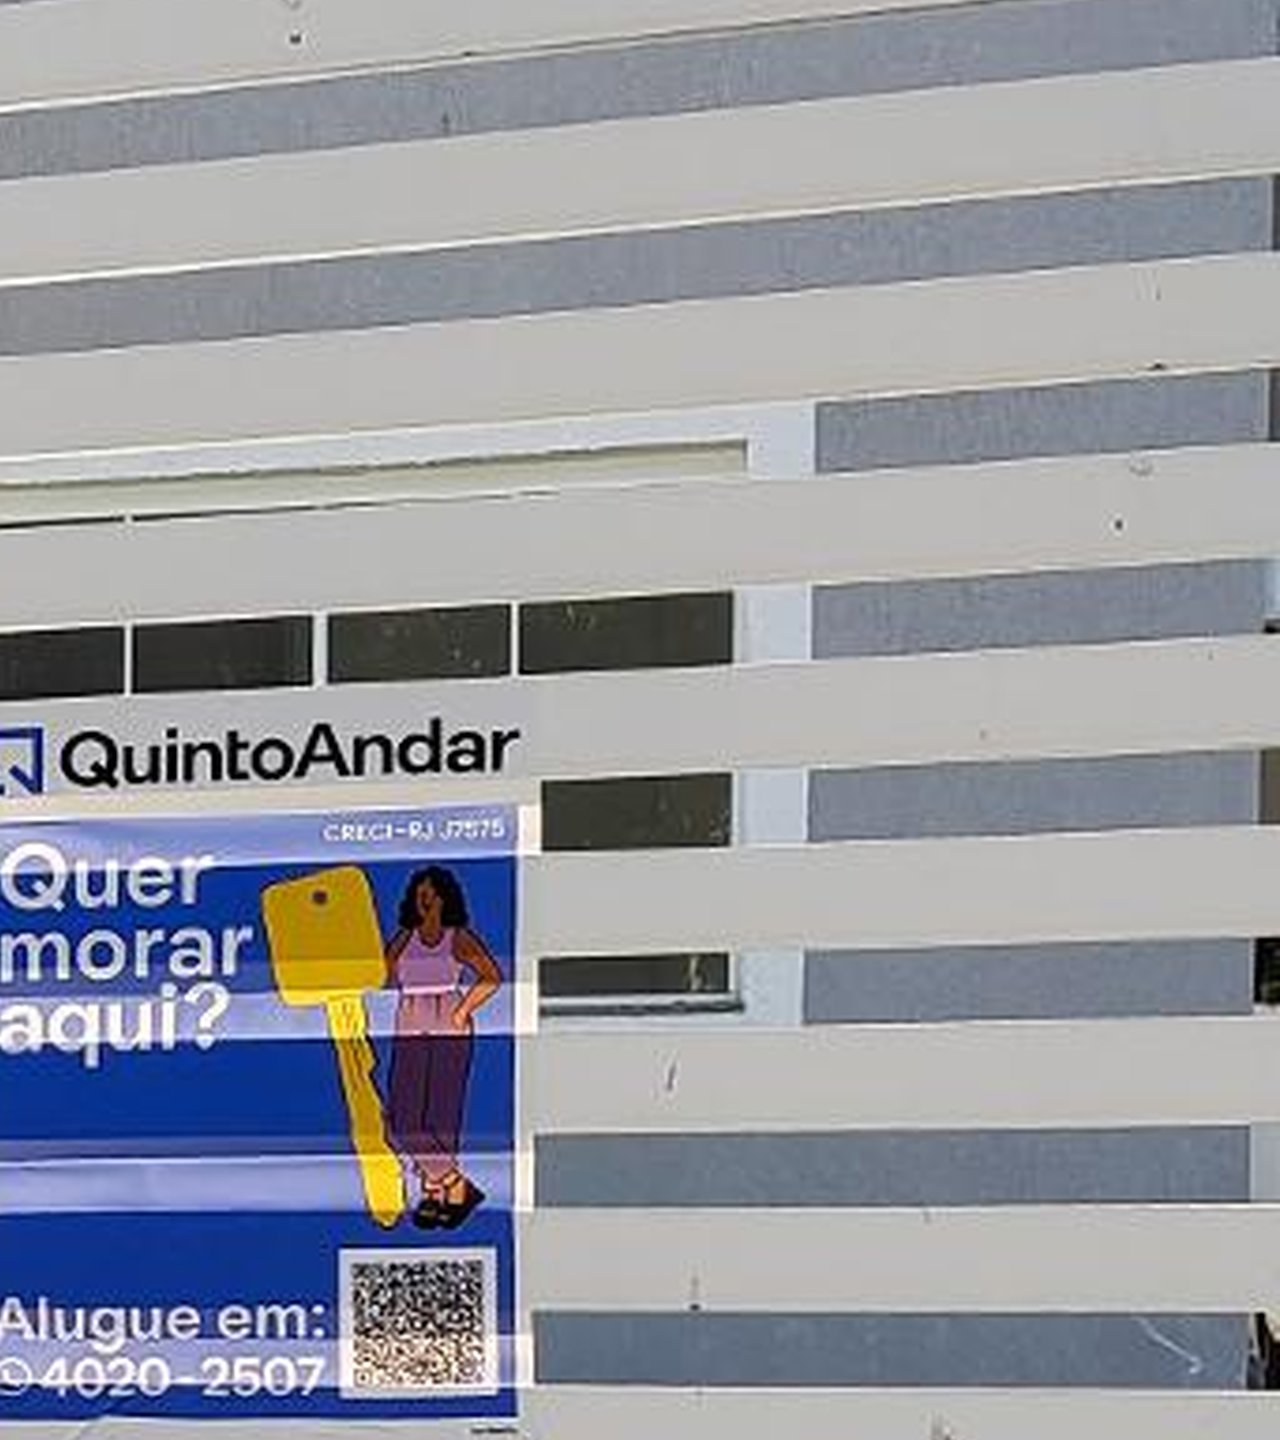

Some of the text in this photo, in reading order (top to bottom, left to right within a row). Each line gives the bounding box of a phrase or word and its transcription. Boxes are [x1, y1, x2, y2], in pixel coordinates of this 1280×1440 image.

[60, 717, 521, 789] QuintoAndar
[0, 843, 213, 912] Quer
[0, 924, 255, 984] morar
[217, 1302, 326, 1339] em:
